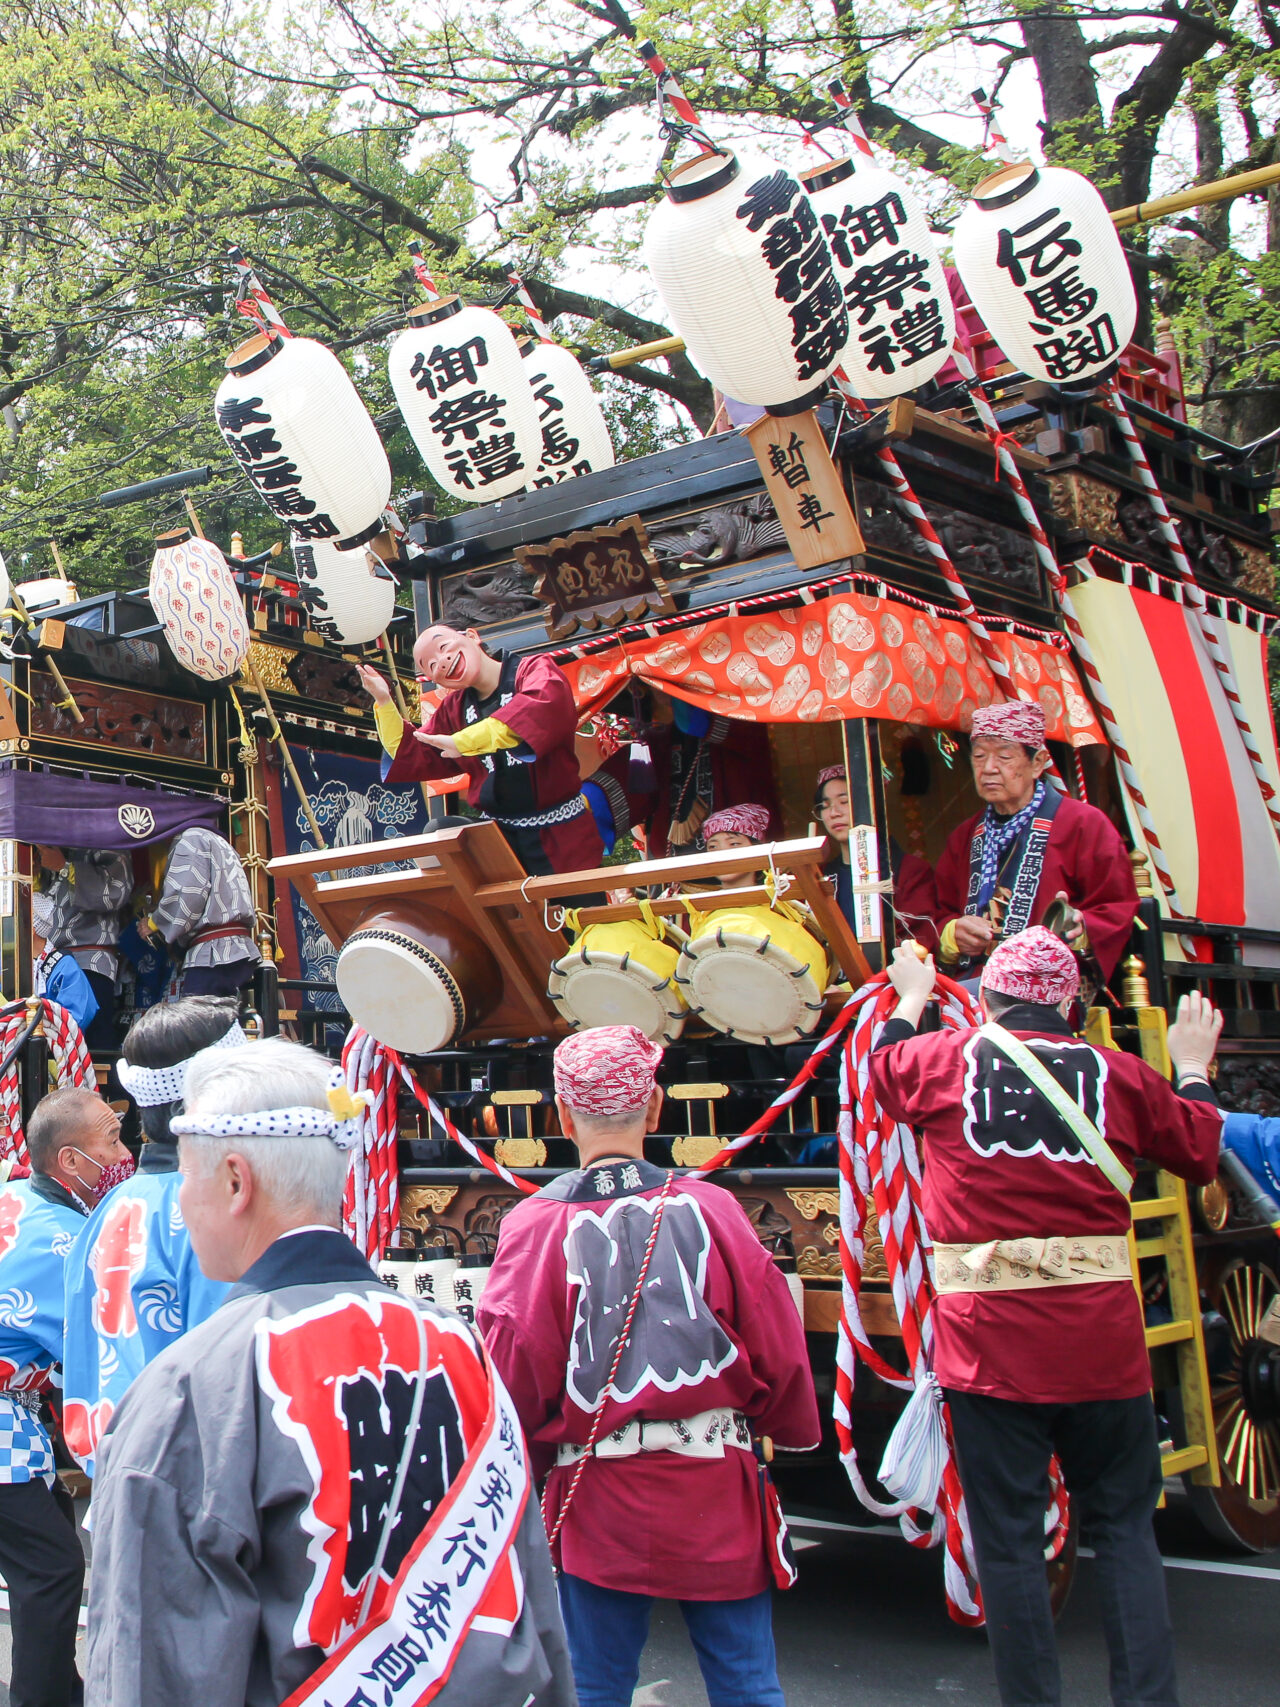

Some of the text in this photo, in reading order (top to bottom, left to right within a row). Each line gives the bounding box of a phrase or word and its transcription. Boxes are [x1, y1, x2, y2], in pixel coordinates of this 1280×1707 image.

[820, 191, 948, 376] 御祭禮
[996, 207, 1120, 379] 伝馬踟
[409, 336, 526, 489] 御祭禮
[768, 431, 836, 534] 暫車
